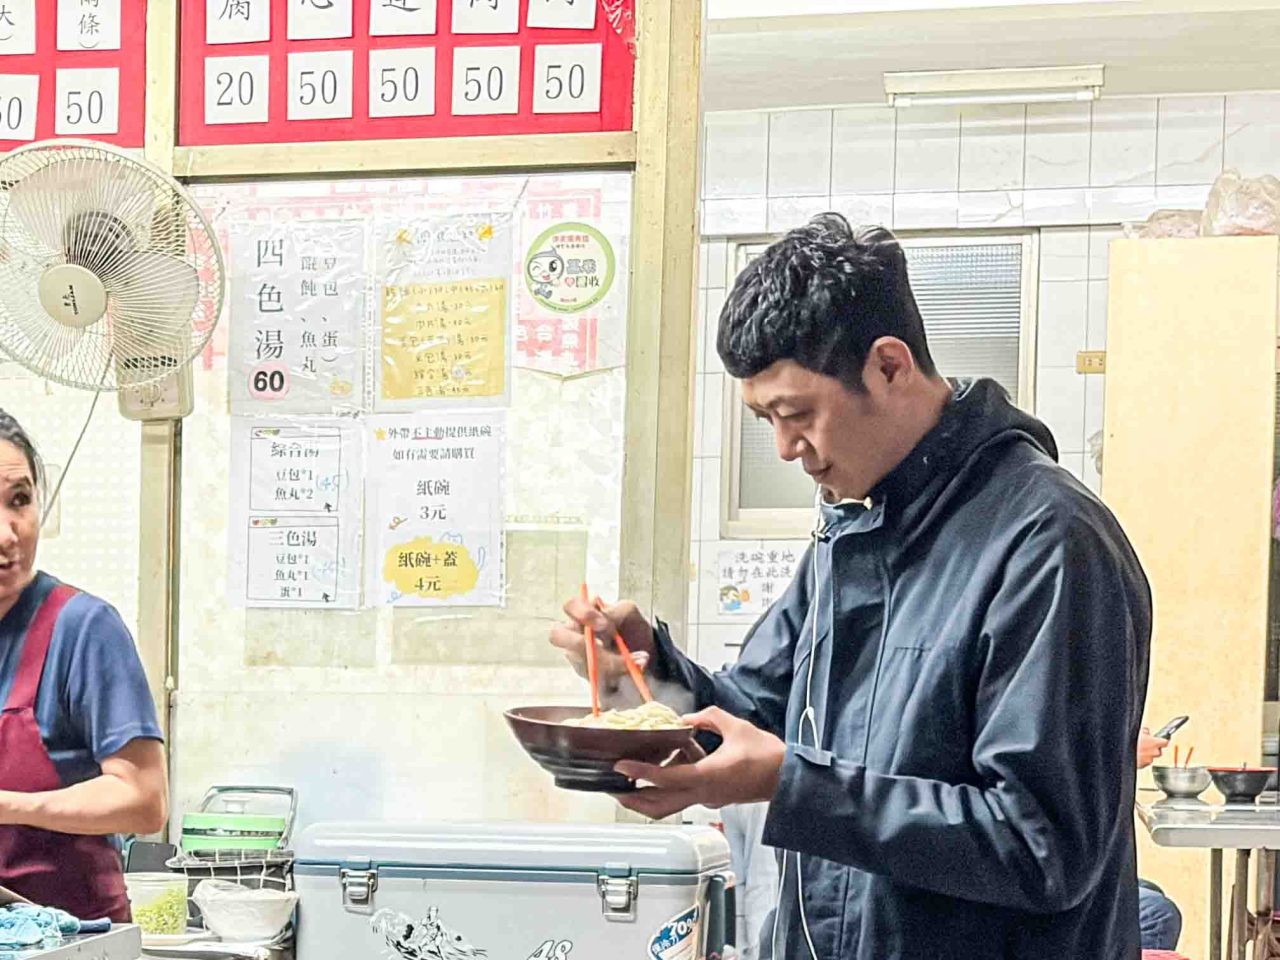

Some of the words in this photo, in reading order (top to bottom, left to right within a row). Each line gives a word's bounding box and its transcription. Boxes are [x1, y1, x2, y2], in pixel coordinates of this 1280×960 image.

[216, 71, 254, 106] 20
[299, 69, 337, 106] 50
[380, 66, 419, 103] 50
[464, 66, 503, 101] 50
[545, 64, 585, 100] 50
[66, 90, 103, 124] 50
[255, 239, 284, 360] 四色湯
[253, 370, 285, 393] 60
[416, 479, 450, 496] 紙碗
[419, 504, 447, 520] 3元
[269, 530, 317, 547] 三色湯
[414, 576, 442, 592] 4元
